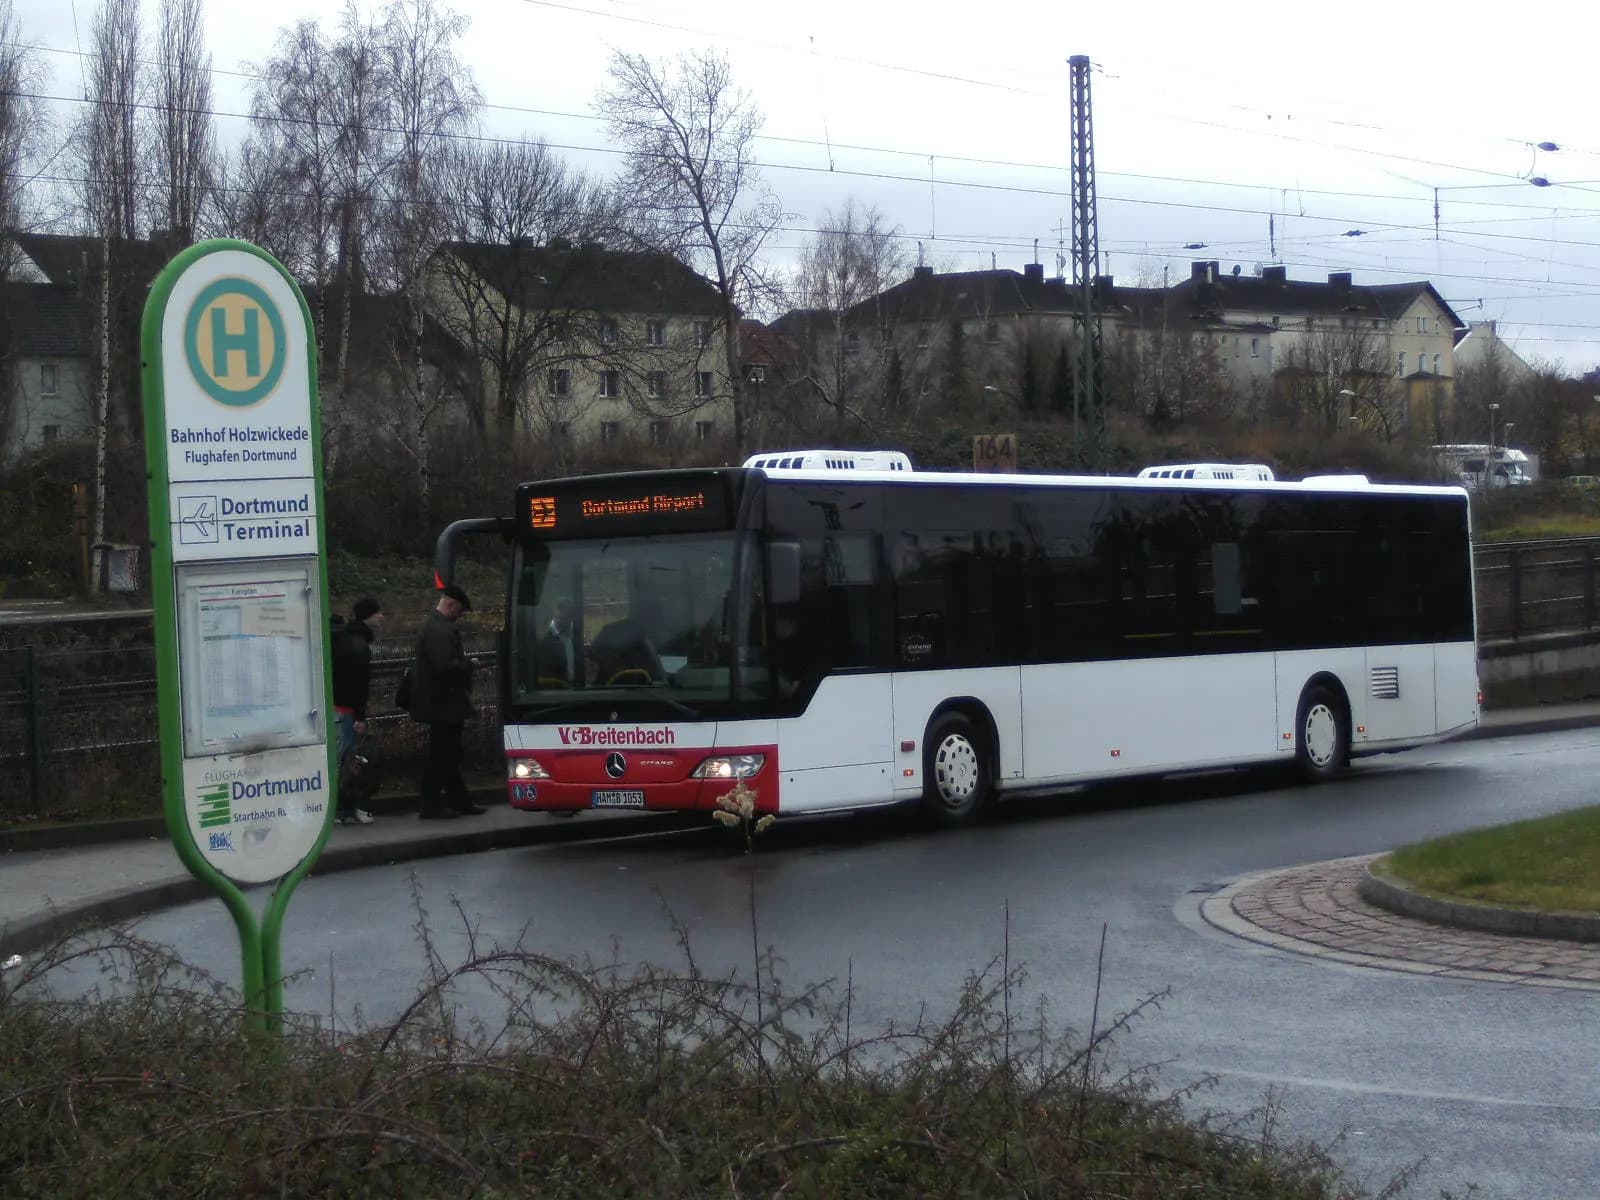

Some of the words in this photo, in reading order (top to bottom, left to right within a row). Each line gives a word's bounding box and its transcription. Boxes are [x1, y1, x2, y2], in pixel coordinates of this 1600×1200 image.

[211, 307, 261, 377] H
[171, 427, 226, 443] Bahnhof
[229, 426, 308, 442] Holzwickede
[185, 449, 240, 465] Flughafen
[242, 448, 297, 462] Dortmund
[977, 436, 1010, 459] 164
[221, 494, 309, 515] Dortmund
[582, 496, 650, 516] Dortmund
[653, 492, 704, 512] Airport
[223, 519, 310, 541] Terminal
[232, 771, 322, 800] Dortmund
[623, 792, 643, 804] 1053
